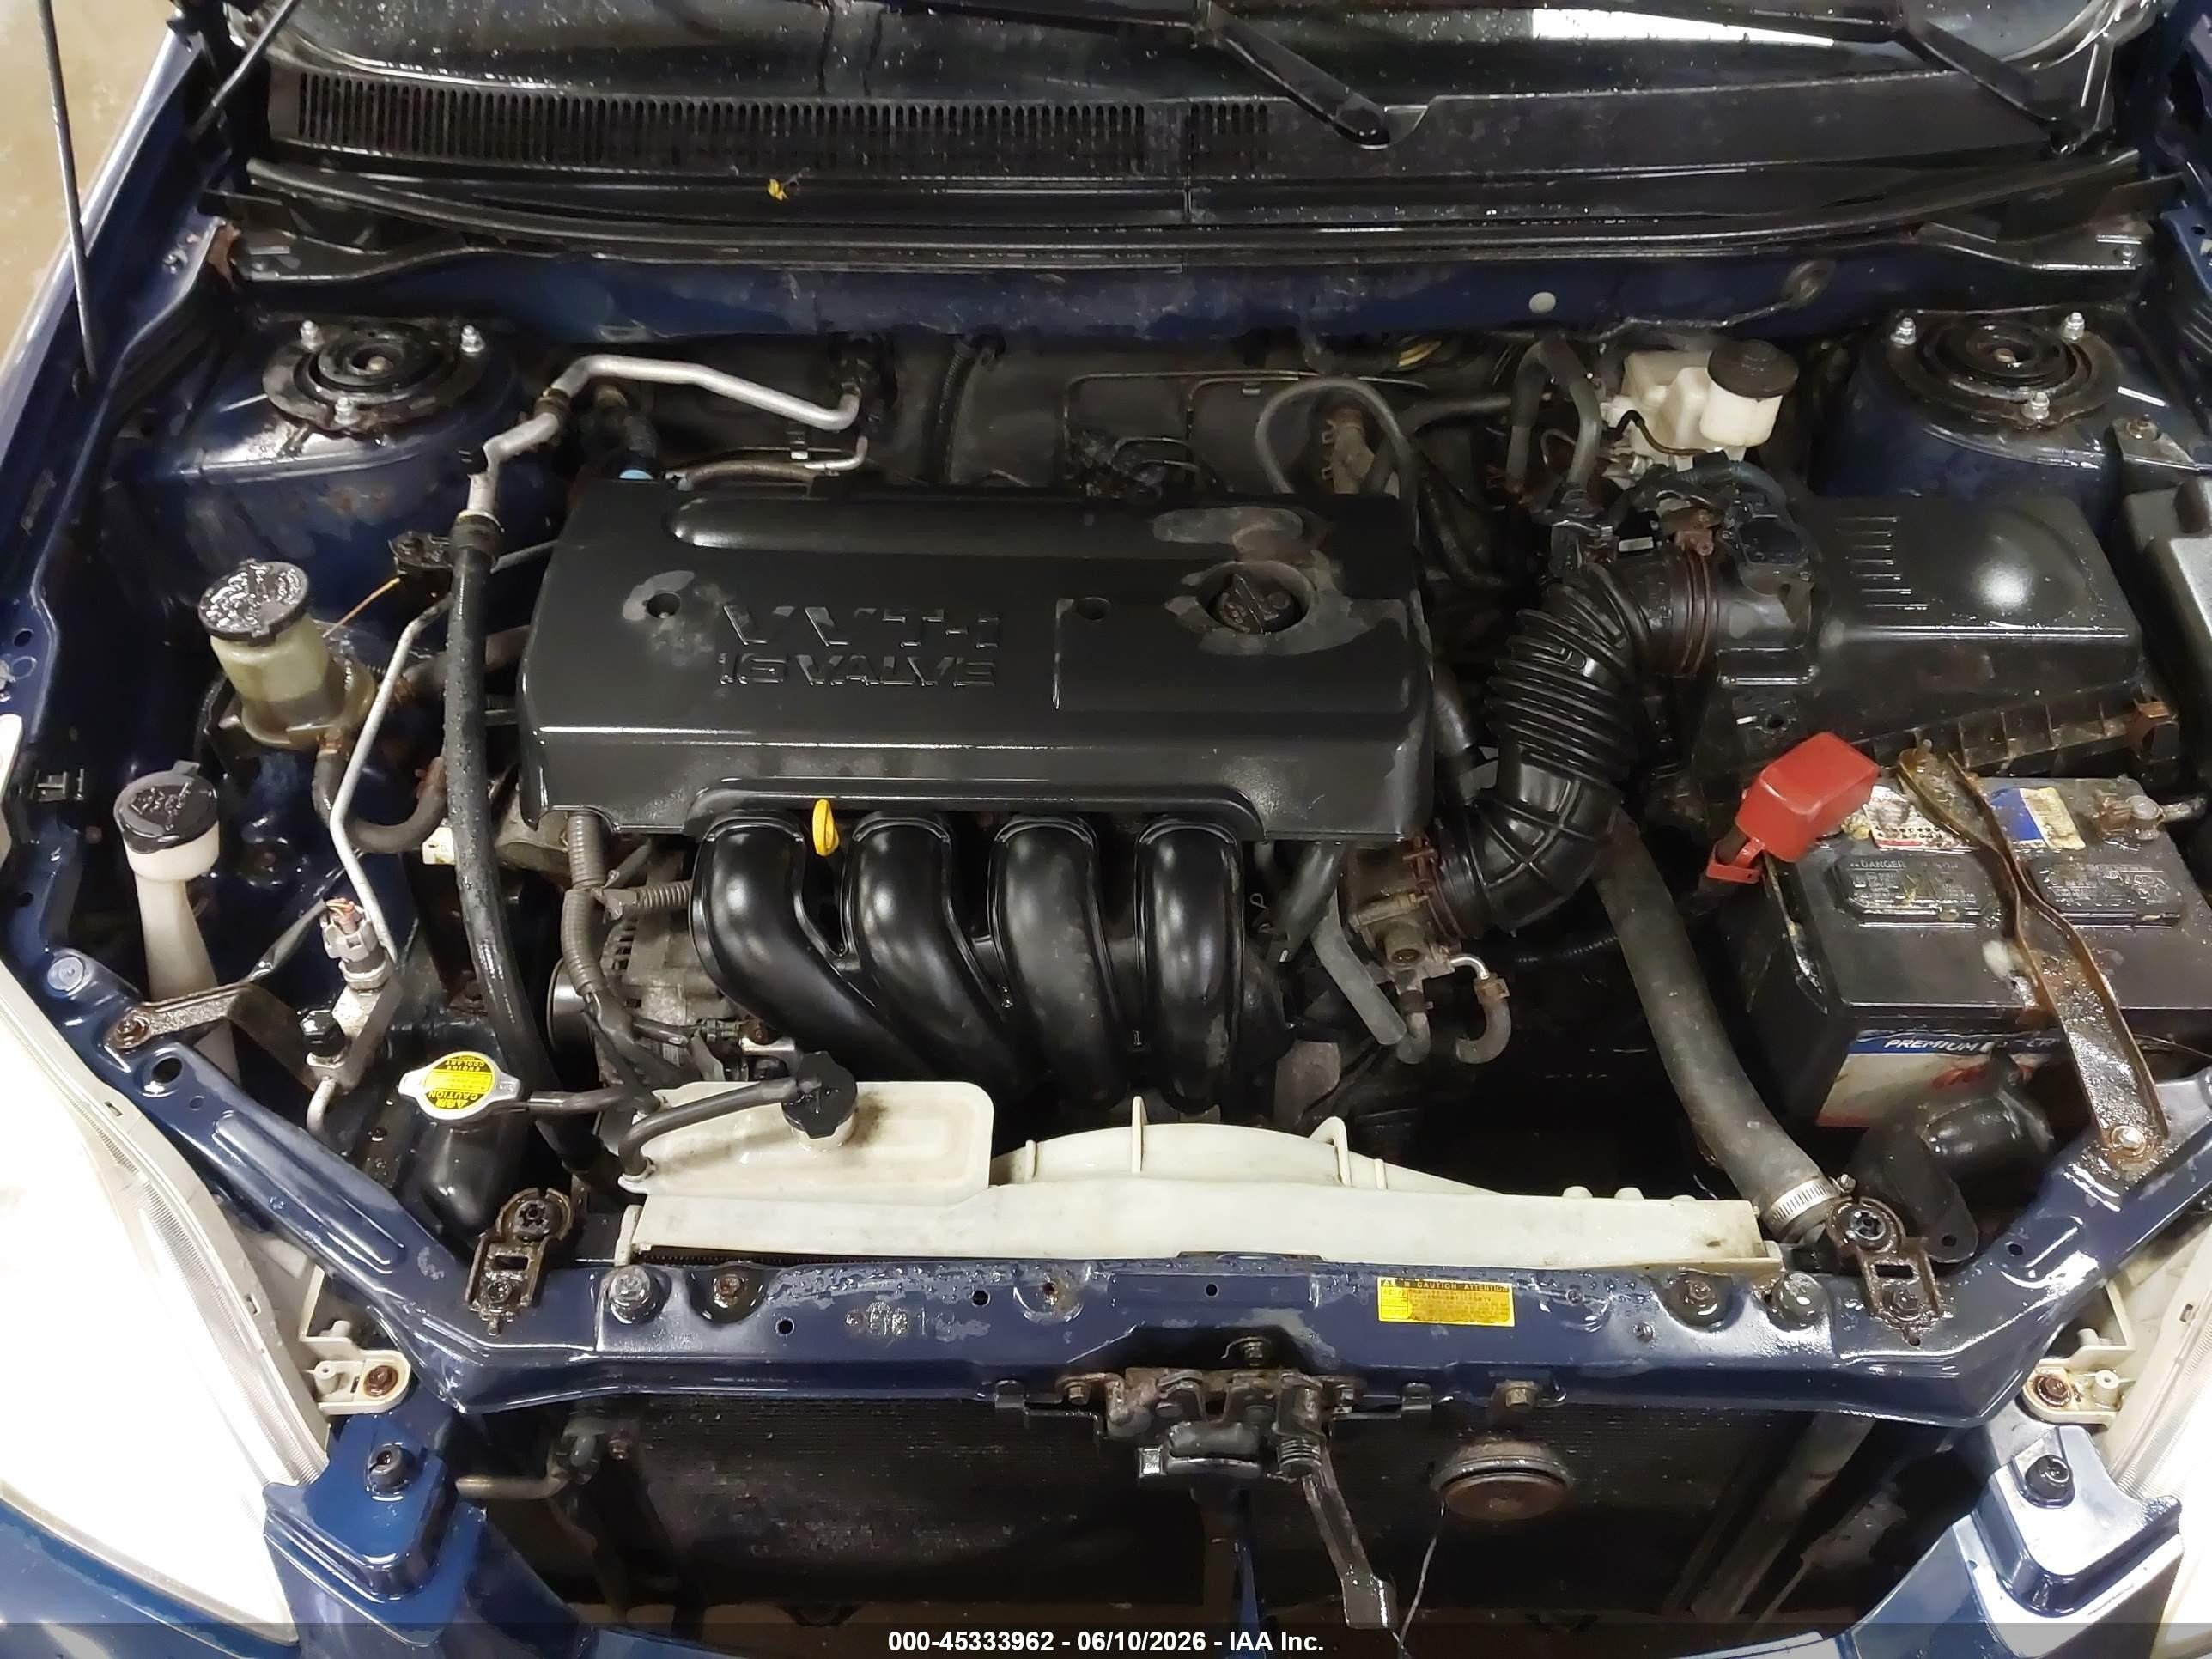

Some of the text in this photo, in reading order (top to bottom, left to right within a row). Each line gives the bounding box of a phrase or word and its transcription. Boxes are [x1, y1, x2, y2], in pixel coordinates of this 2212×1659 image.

[718, 653, 997, 688] 16 VALVE
[1884, 1038, 1979, 1052] PREMIUM
[428, 1090, 478, 1101] CAUTION
[1417, 1280, 1457, 1290] CAUTION
[1462, 1283, 1510, 1292] ATTENTION
